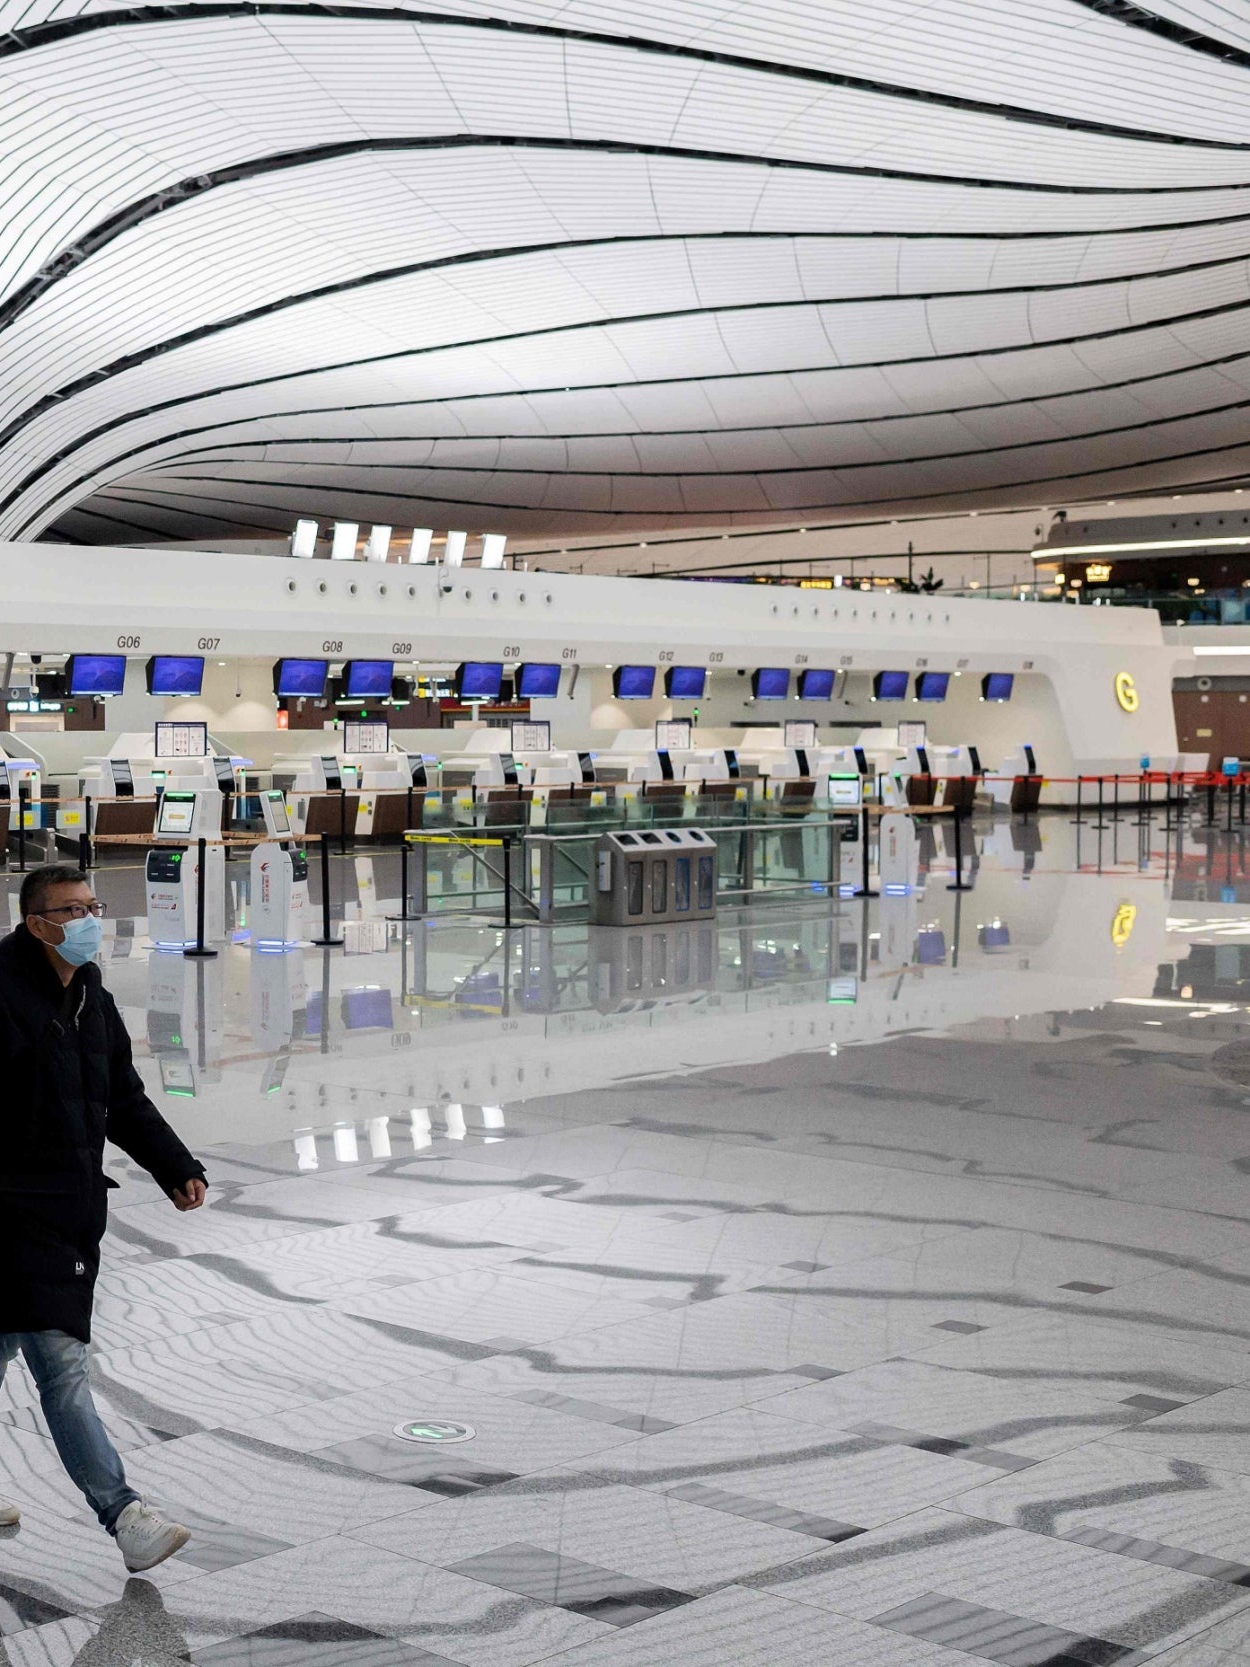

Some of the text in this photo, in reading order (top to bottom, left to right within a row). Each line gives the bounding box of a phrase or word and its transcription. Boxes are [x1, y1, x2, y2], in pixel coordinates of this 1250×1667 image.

[116, 635, 141, 649] G06
[197, 637, 221, 651] G07
[322, 640, 343, 653] G08
[392, 642, 412, 654] G09
[503, 646, 520, 658] G10
[562, 647, 577, 659] G11
[658, 650, 674, 662] G12
[708, 652, 724, 663] G13
[1115, 671, 1139, 712] G
